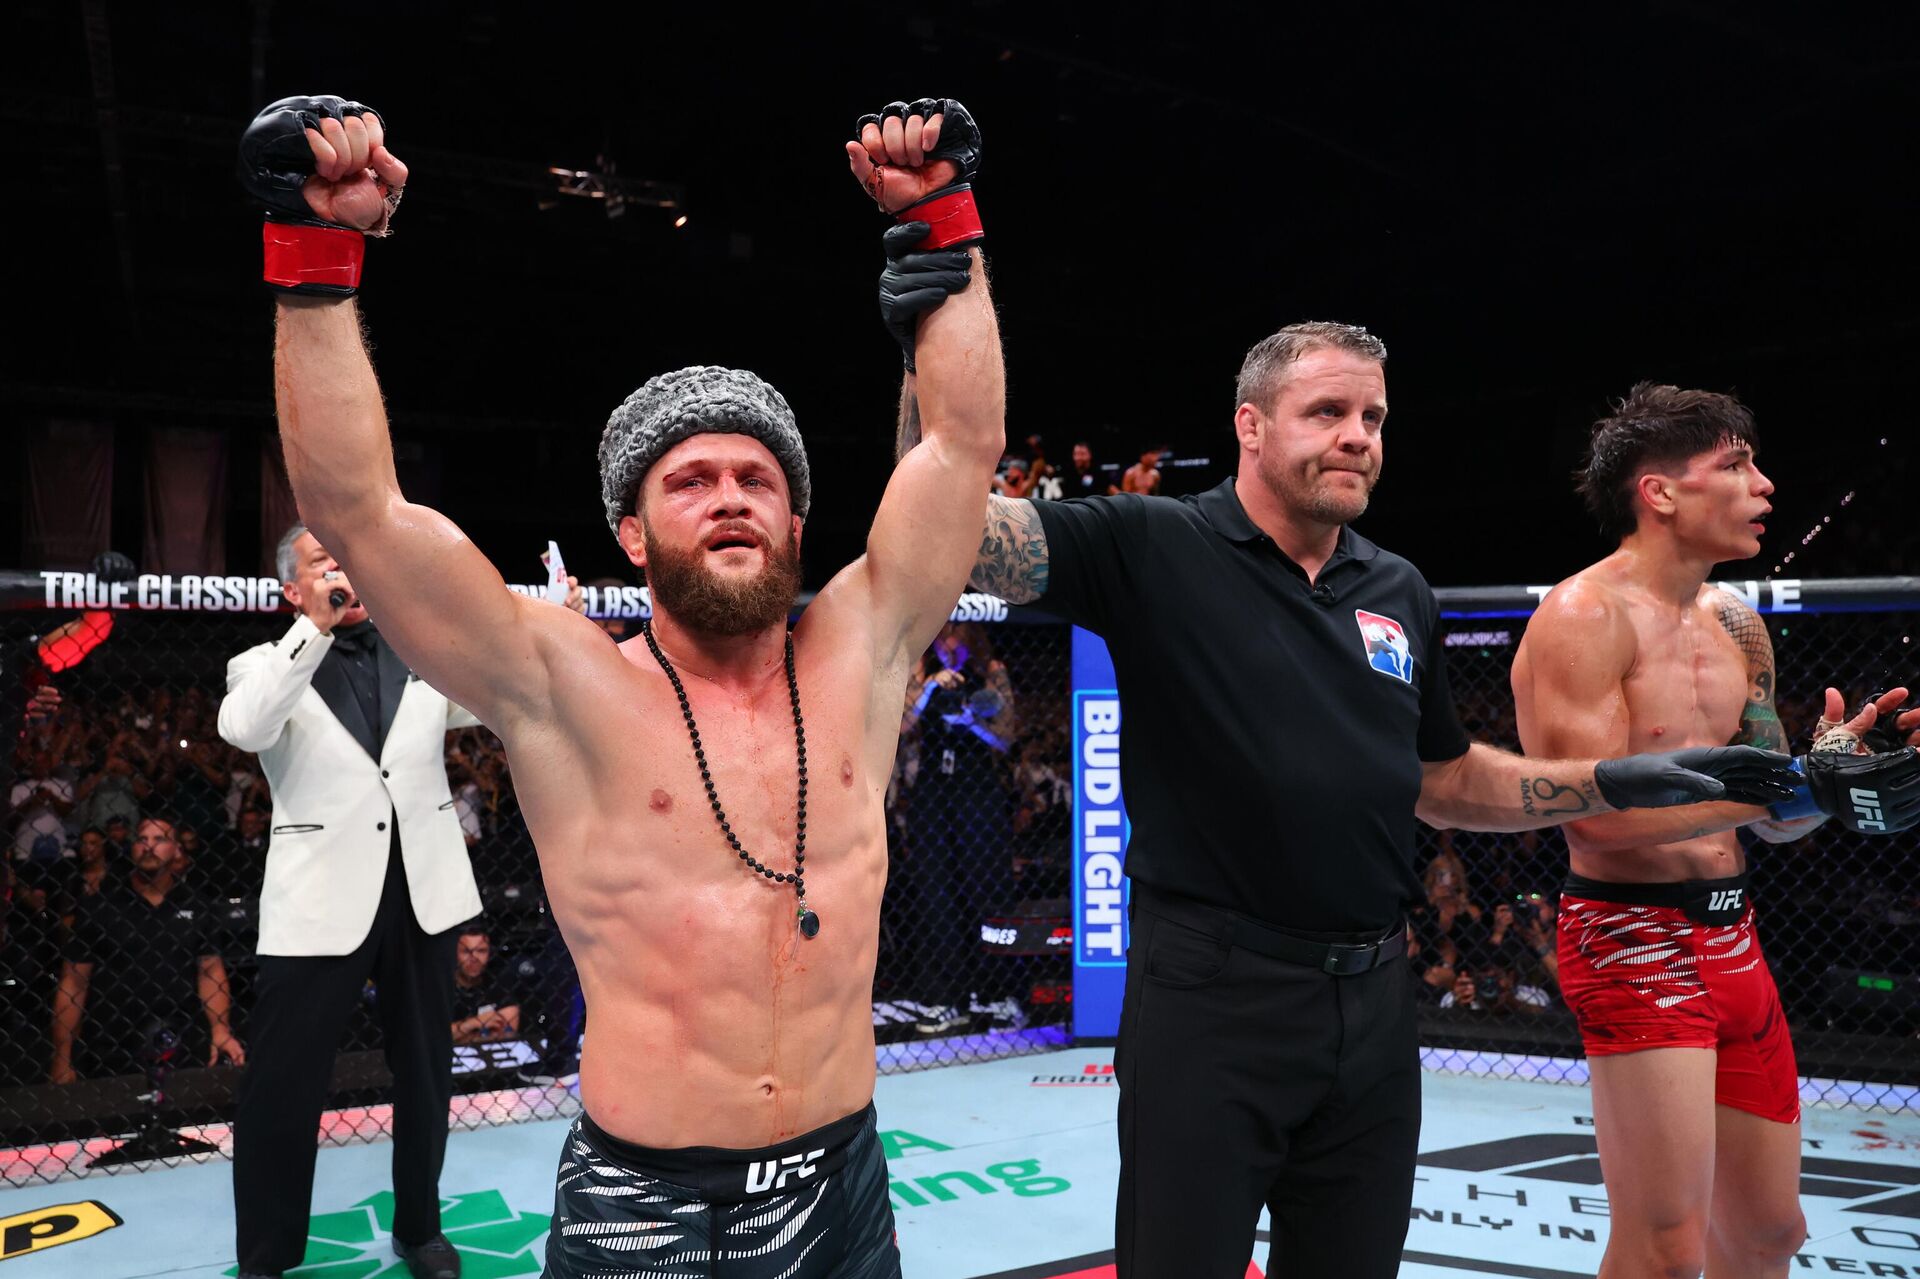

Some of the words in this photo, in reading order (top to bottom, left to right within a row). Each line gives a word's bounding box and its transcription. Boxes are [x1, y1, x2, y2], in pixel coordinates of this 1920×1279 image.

[39, 571, 130, 609] TRUE
[137, 574, 280, 612] CLASSIC
[949, 592, 1009, 622] SSIC
[1083, 700, 1121, 805] BUD
[1849, 787, 1886, 831] UFC
[1084, 810, 1123, 957] LIGHT
[1708, 888, 1743, 911] UFC
[745, 1148, 825, 1194] UFC
[889, 1158, 1072, 1210] ing
[1410, 1207, 1513, 1231] NLY
[1538, 1222, 1596, 1243] IN
